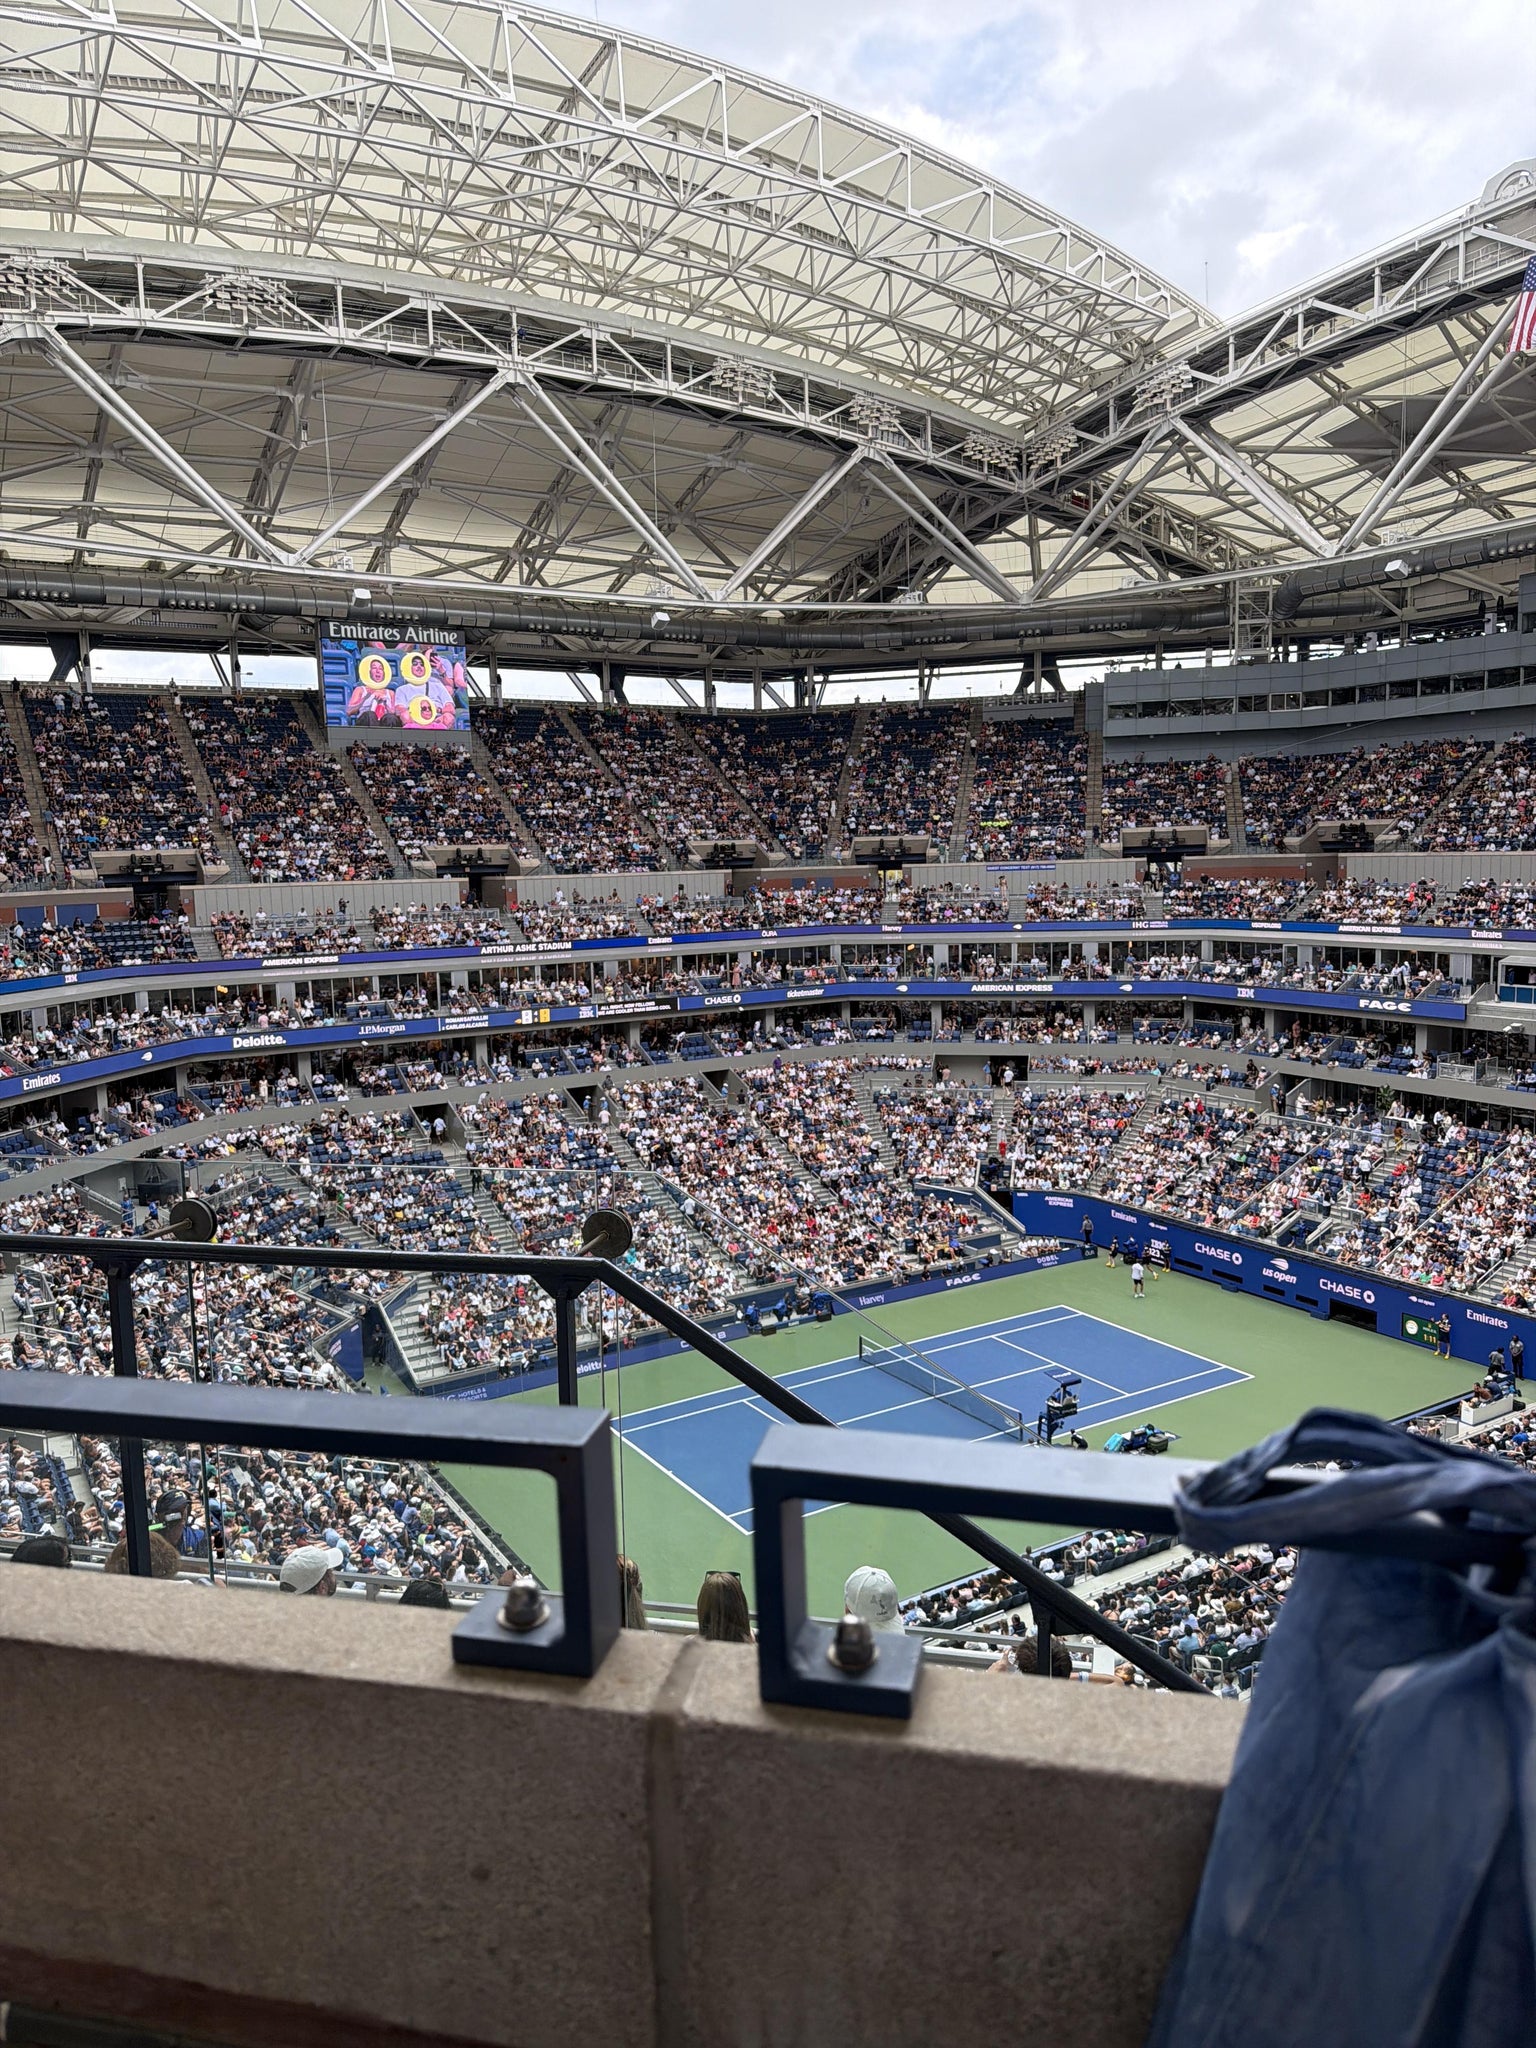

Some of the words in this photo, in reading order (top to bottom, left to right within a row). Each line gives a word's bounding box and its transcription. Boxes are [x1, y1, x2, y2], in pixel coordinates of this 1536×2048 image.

[328, 621, 401, 641] Emirates
[404, 626, 458, 645] Airline
[882, 924, 902, 933] Harvey
[1132, 921, 1149, 929] IHG
[1372, 926, 1401, 934] EXPRESS
[1471, 929, 1503, 939] Emirates
[648, 936, 673, 945] Emirates
[481, 944, 514, 955] ARTHUR
[515, 943, 537, 952] ASHE
[538, 941, 572, 950] STADIUM
[262, 957, 303, 967] AMERICAN
[304, 955, 339, 964] EXPRESS
[786, 988, 824, 999] ticketmaster
[971, 984, 1014, 992] AMERICAN
[1015, 984, 1053, 992] EXPRESS
[1237, 987, 1254, 998] IBM
[704, 994, 733, 1006] CHASE
[358, 1023, 406, 1035] J.P.Morgan
[232, 1034, 287, 1049] Deloitte.
[23, 1073, 60, 1090] Emirates
[1044, 1195, 1074, 1203] AMERICAN
[1048, 1200, 1074, 1208] EXPRESS
[1111, 1209, 1138, 1224] Emirates
[1194, 1242, 1231, 1262] CHASE
[1036, 1253, 1060, 1264] DOBEL
[1262, 1267, 1274, 1277] us
[1274, 1270, 1297, 1285] open
[1319, 1278, 1362, 1300] CHASE
[859, 1293, 885, 1306] Harvey
[1466, 1308, 1509, 1330] Emirates
